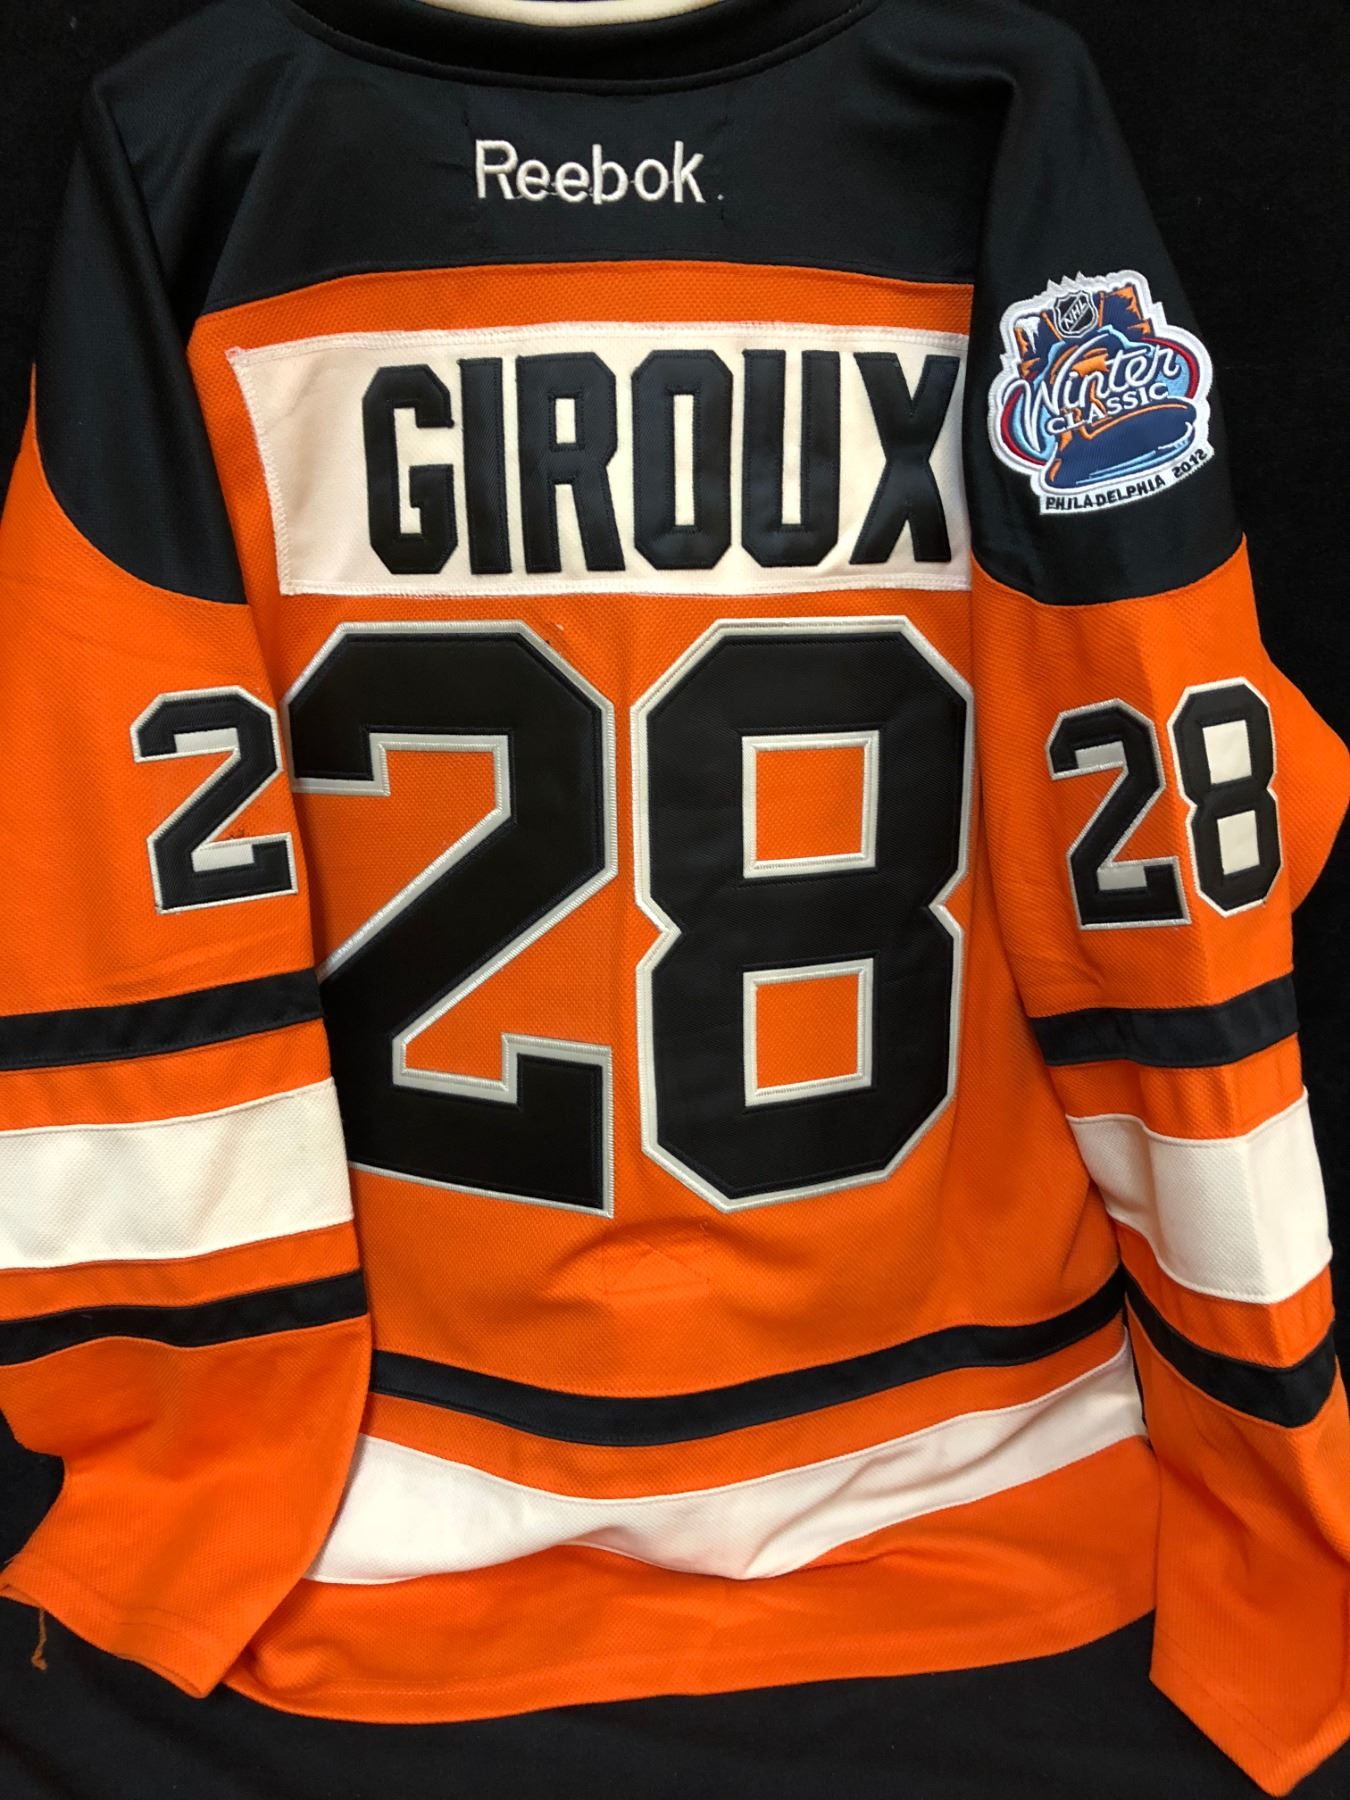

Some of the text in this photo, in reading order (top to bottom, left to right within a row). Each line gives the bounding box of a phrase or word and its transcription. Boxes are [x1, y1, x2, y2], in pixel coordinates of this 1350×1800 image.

[475, 138, 706, 205] Reebok
[1062, 297, 1088, 331] NHL
[1002, 334, 1181, 452] Winter
[1046, 382, 1170, 435] CLASSIC
[361, 348, 961, 575] GIROUX
[1045, 450, 1209, 511] PHILADELPHIA 2012
[129, 685, 299, 915] 2
[1044, 676, 1284, 931] 28
[283, 615, 974, 1218] 28
